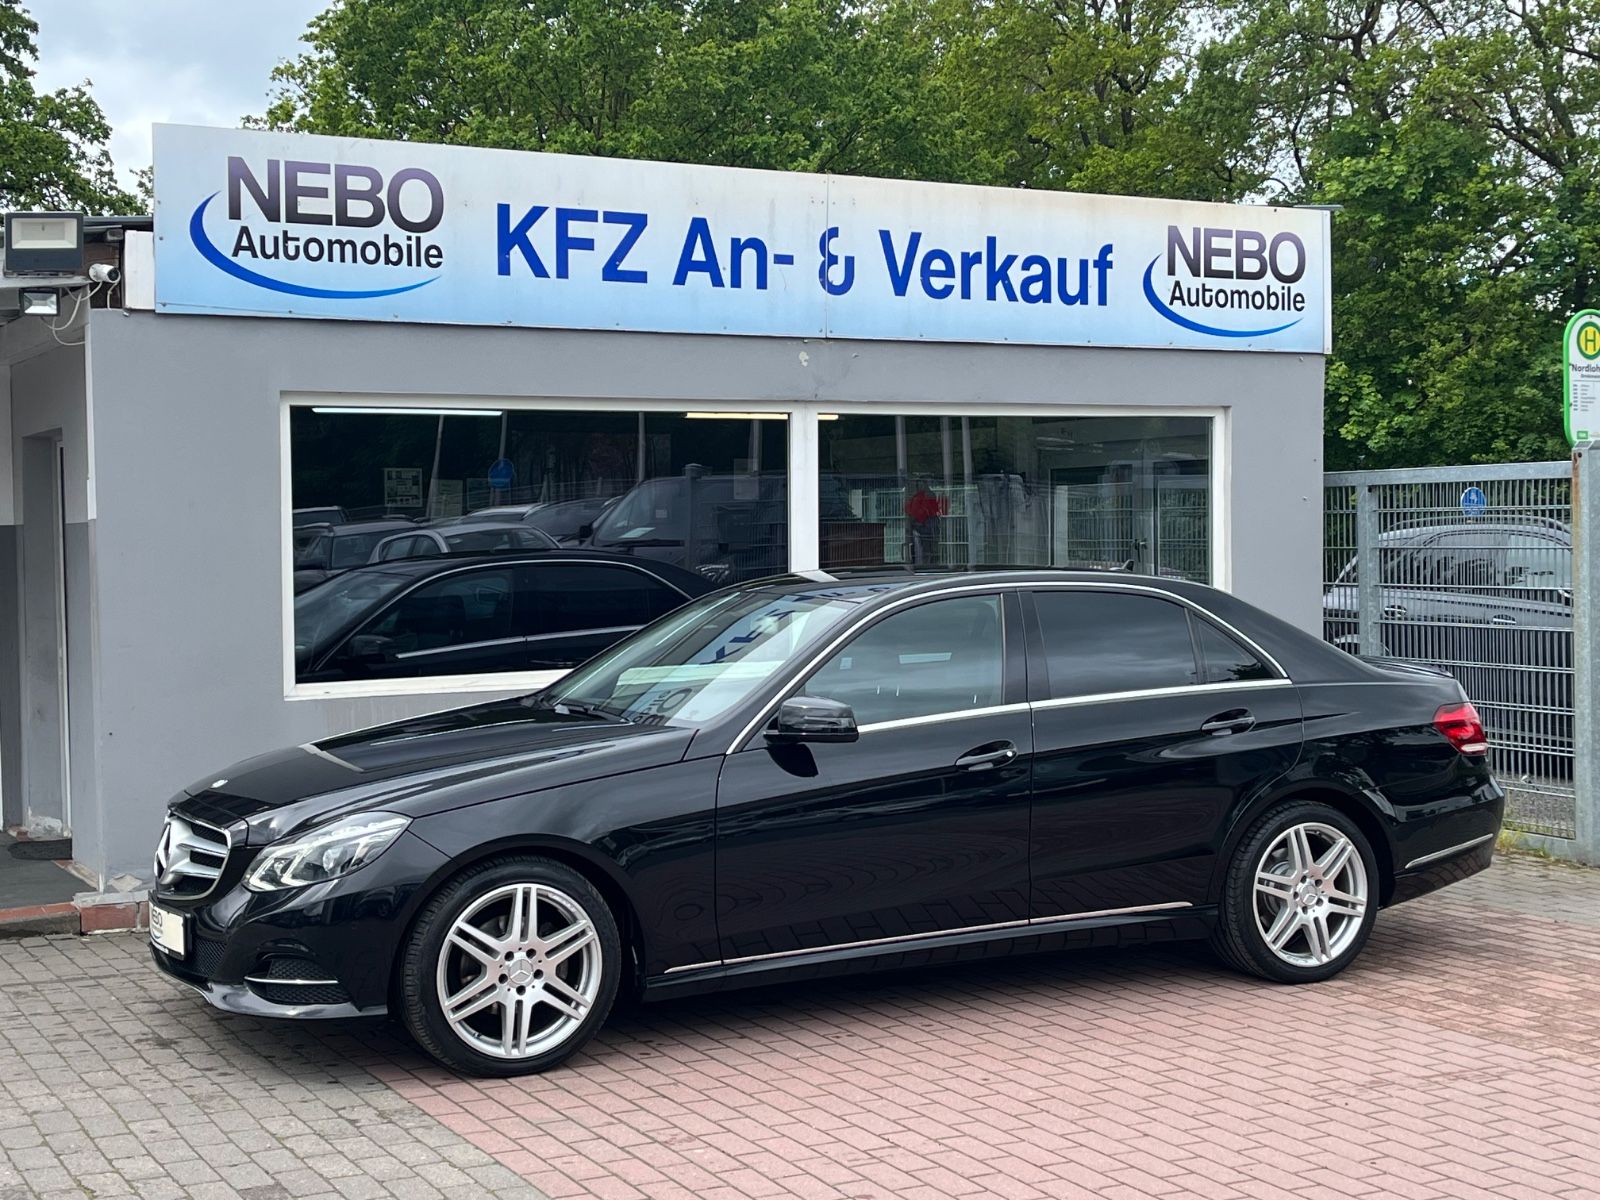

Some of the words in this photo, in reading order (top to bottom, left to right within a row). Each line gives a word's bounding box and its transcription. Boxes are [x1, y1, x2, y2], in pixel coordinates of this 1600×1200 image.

[228, 156, 444, 233] NEBO
[231, 226, 443, 268] Automobile
[498, 202, 648, 283] KFZ
[672, 216, 794, 290] An-
[818, 226, 855, 295] &
[879, 229, 1113, 306] Verkauf
[1167, 225, 1306, 283] NEBO
[1169, 280, 1305, 312] Automobile
[1584, 329, 1597, 351] H
